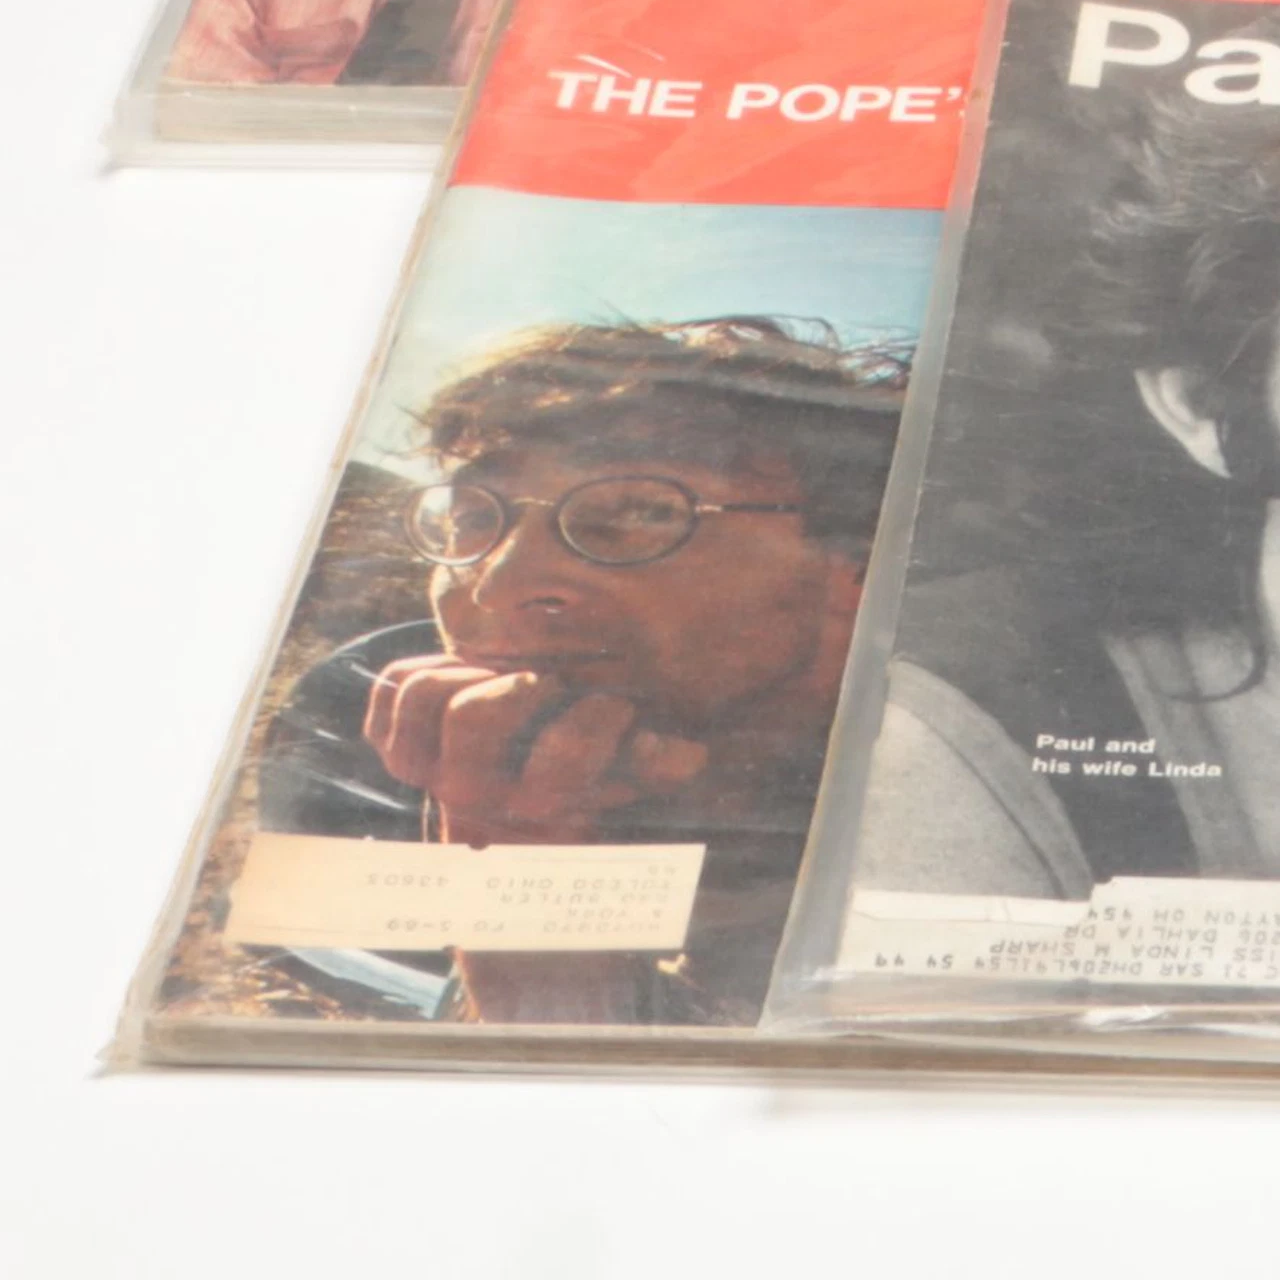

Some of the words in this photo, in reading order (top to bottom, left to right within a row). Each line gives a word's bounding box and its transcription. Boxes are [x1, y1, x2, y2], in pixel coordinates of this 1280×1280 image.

[548, 69, 705, 120] THE
[726, 81, 967, 124] POPE'
[1036, 733, 1095, 752] Paul
[1105, 736, 1157, 755] and
[1031, 757, 1072, 775] his
[1081, 759, 1138, 778] wife
[1147, 760, 1223, 779] Linda
[987, 939, 1076, 956] SHARP
